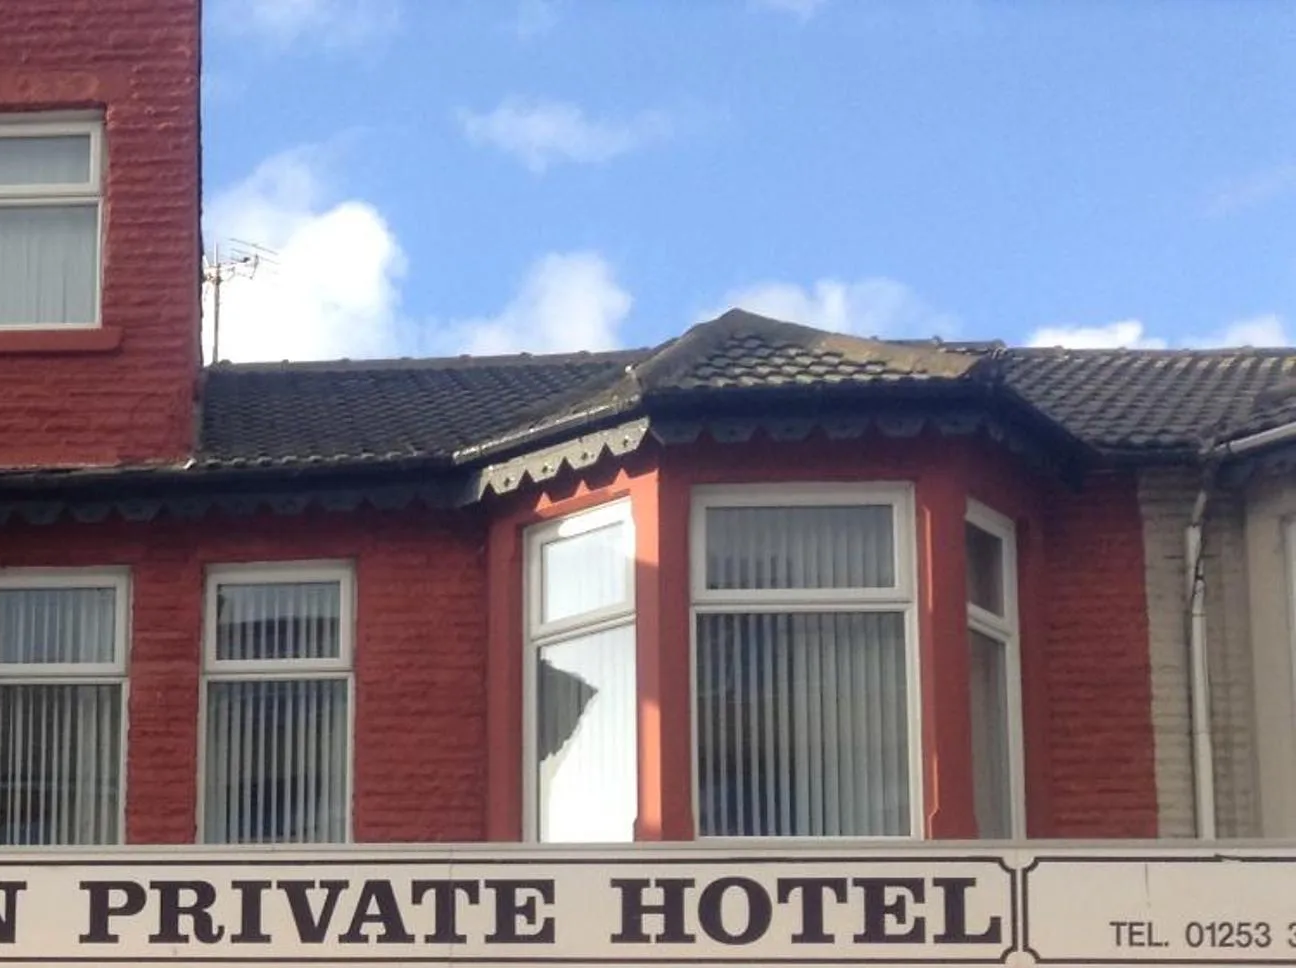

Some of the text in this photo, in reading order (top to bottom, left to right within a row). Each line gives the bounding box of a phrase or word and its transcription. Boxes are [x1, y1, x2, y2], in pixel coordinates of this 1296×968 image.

[78, 879, 556, 945] PRIVATE
[610, 876, 1002, 946] HOTEL
[1109, 921, 1170, 947] TEL.
[1185, 921, 1272, 948] 01253
